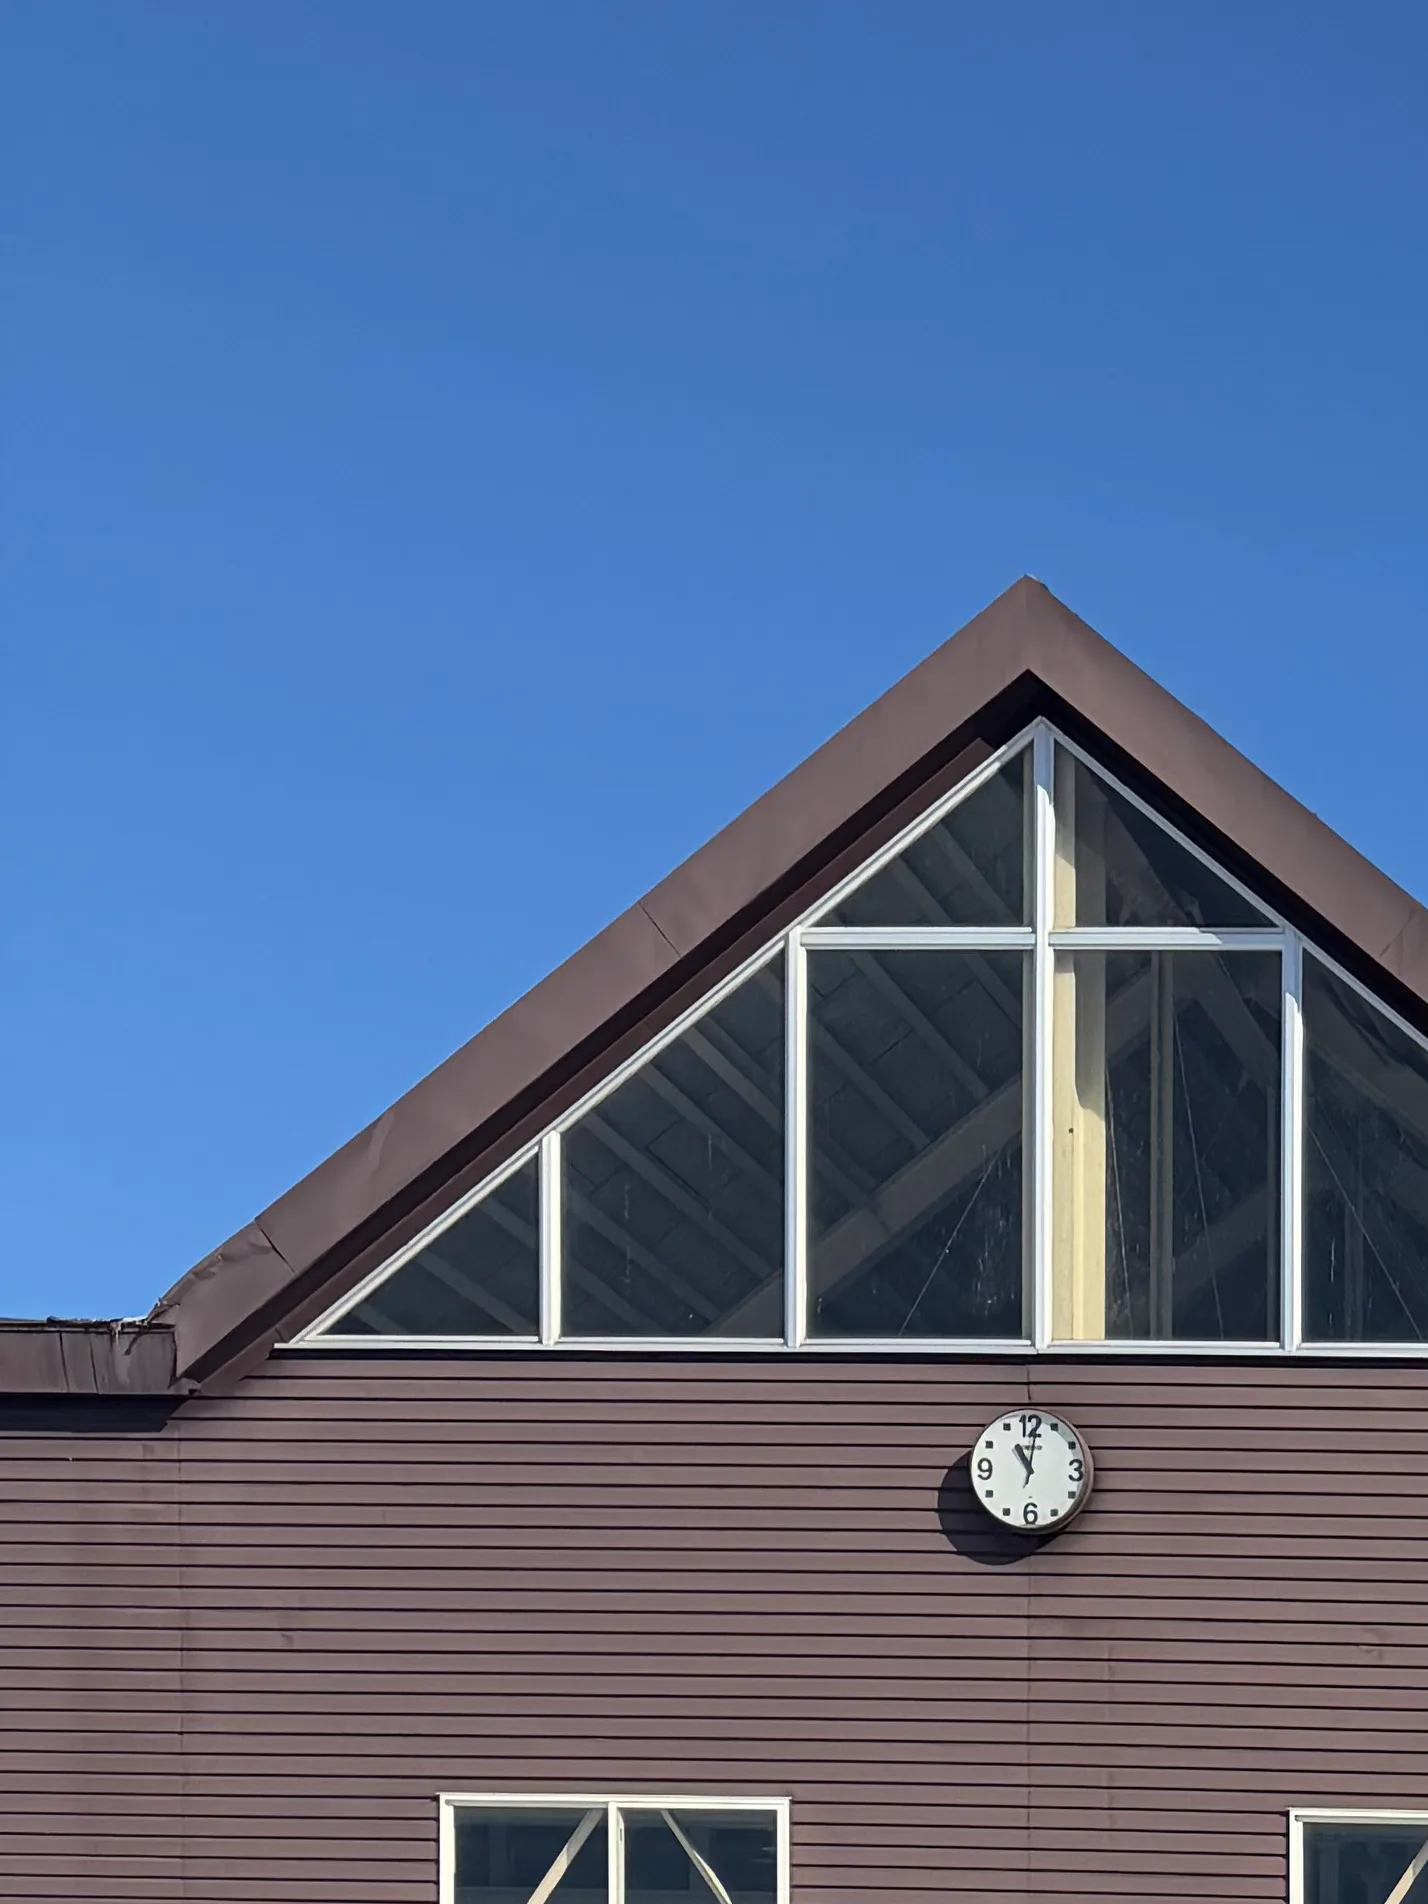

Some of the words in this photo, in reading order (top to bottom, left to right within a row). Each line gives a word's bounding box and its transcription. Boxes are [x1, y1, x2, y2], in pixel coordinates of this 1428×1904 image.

[1019, 1414, 1042, 1438] 12
[977, 1458, 993, 1481] 9
[1068, 1459, 1084, 1482] 3
[1023, 1503, 1039, 1525] 6
